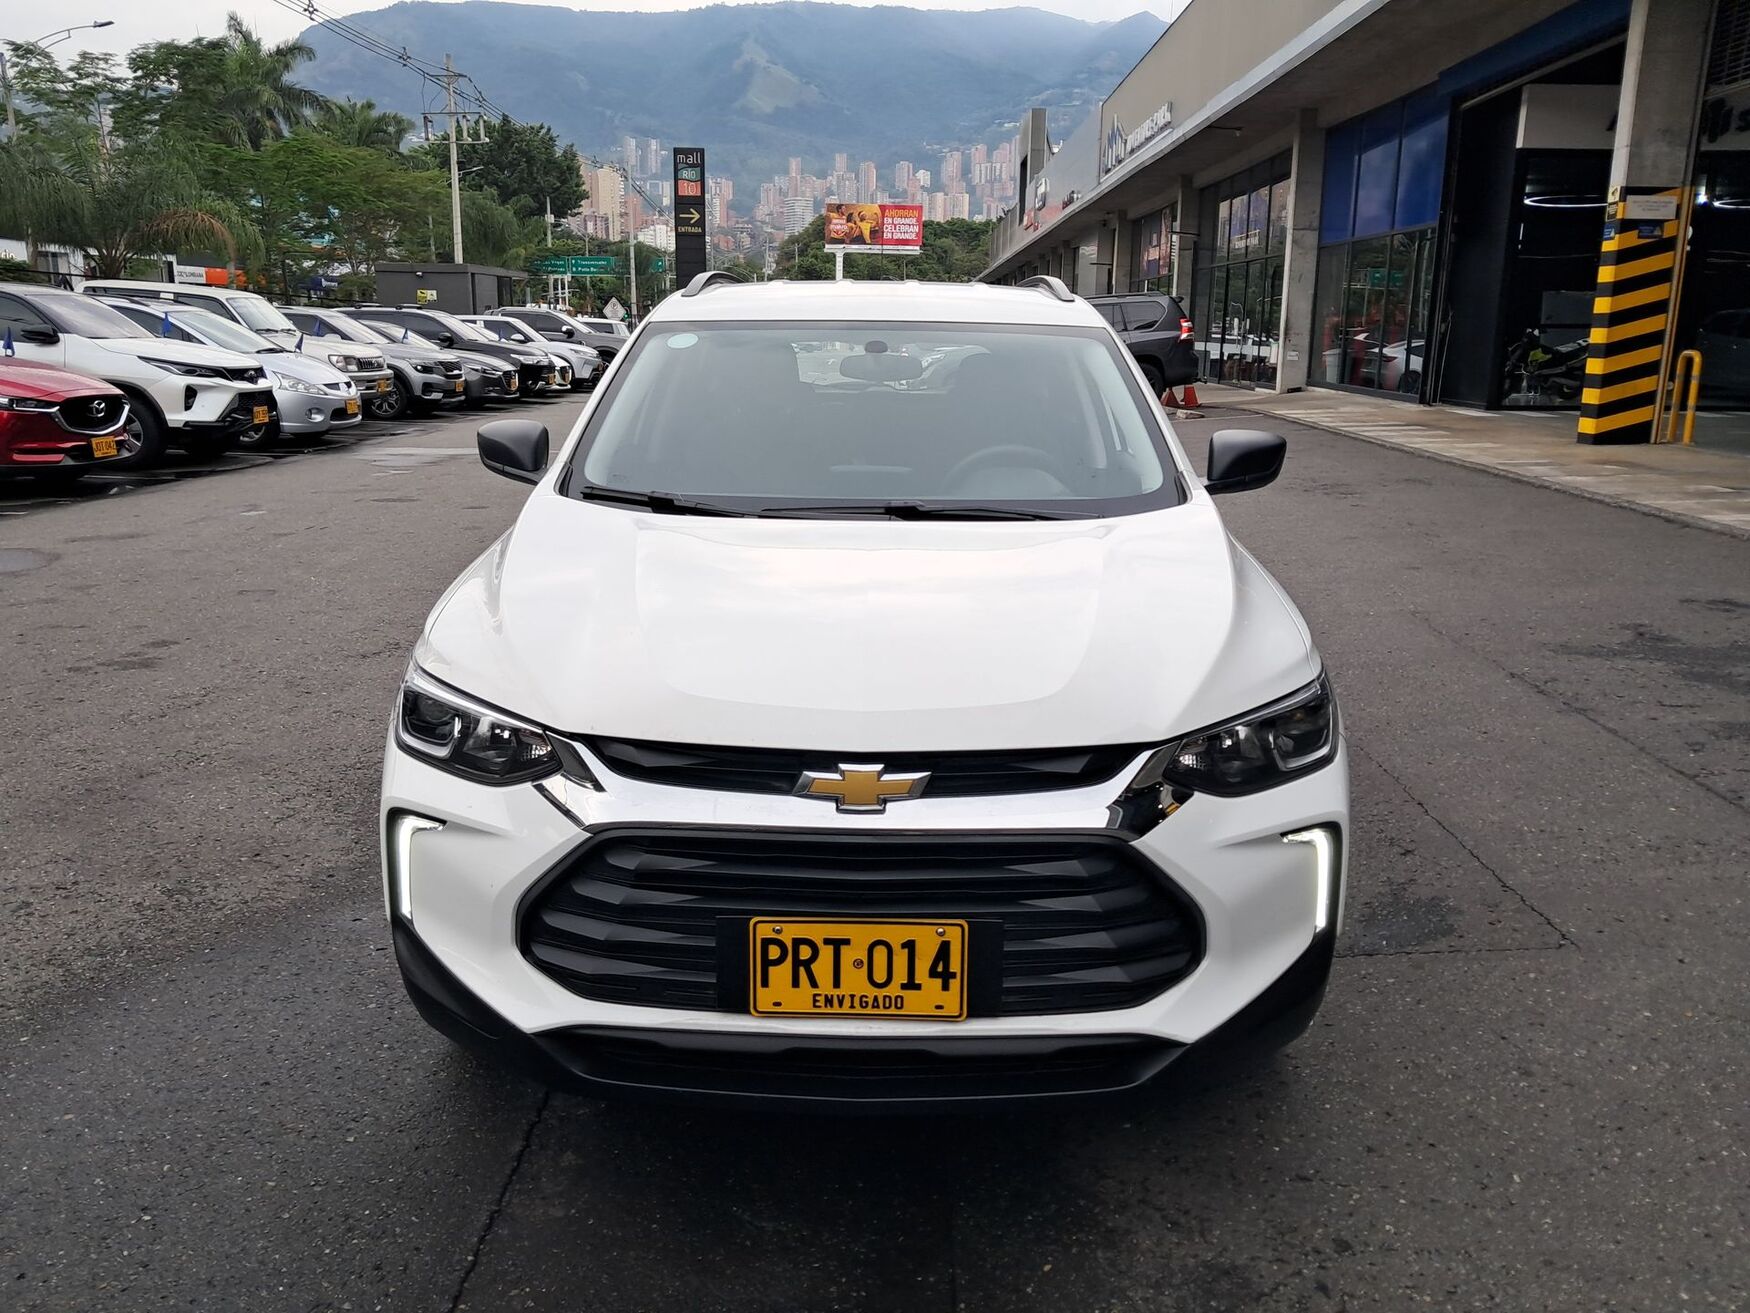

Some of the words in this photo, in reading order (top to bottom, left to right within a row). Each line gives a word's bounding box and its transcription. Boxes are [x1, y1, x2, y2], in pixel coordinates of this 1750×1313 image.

[677, 152, 701, 164] mall
[683, 182, 697, 194] 10
[885, 209, 918, 217] AHORRAN
[883, 224, 919, 232] CELEBRAN
[760, 937, 851, 989] PRT
[867, 939, 957, 991] 014
[812, 993, 905, 1010] ENVIGADO
